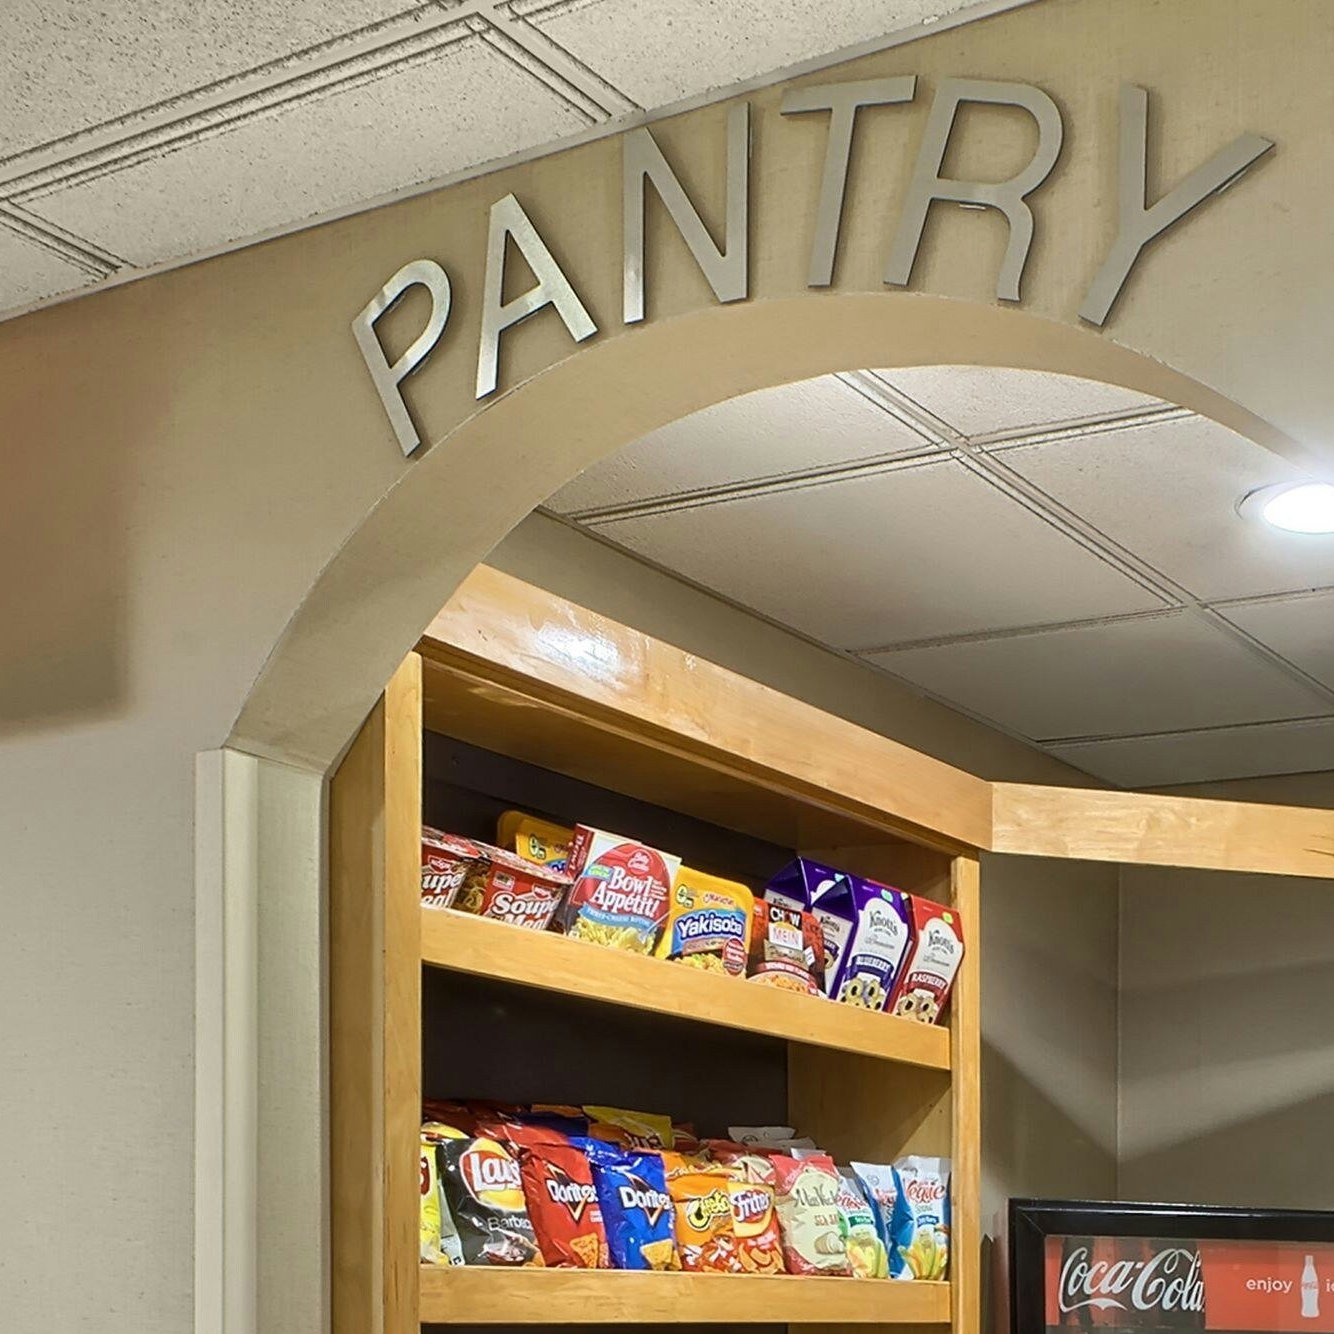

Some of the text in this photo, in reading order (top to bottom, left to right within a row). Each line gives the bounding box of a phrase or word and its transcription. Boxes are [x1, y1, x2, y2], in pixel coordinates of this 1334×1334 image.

[351, 74, 1276, 458] PANTRY
[608, 866, 654, 896] Bowl
[678, 914, 742, 938] Yakisoba
[770, 906, 800, 927] CHW
[1058, 1246, 1205, 1313] Coca-Cola
[1245, 1276, 1293, 1294] enjoy
